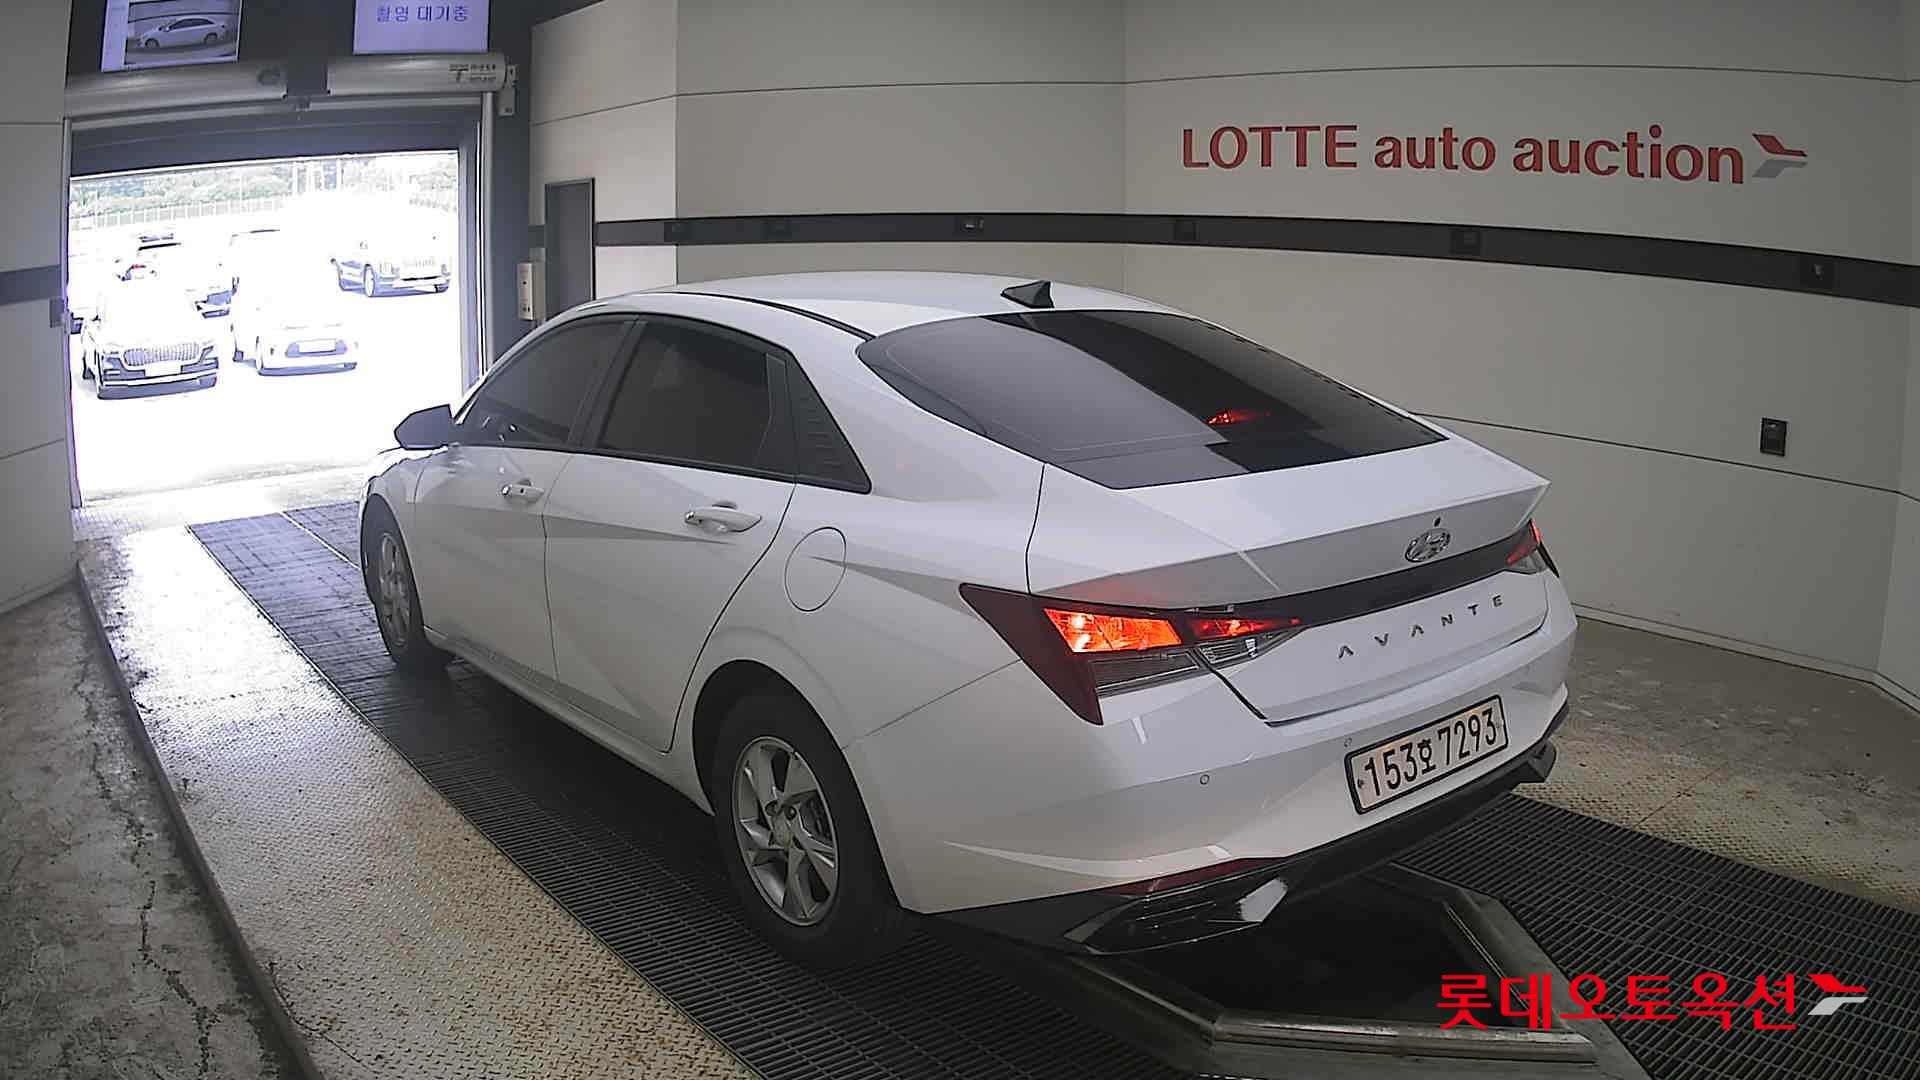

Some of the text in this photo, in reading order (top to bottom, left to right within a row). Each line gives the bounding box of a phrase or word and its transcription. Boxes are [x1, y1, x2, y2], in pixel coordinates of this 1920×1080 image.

[417, 5, 469, 22] 대기중
[1183, 124, 1744, 184] LOTTE auto auction
[1338, 594, 1503, 659] AVANTE
